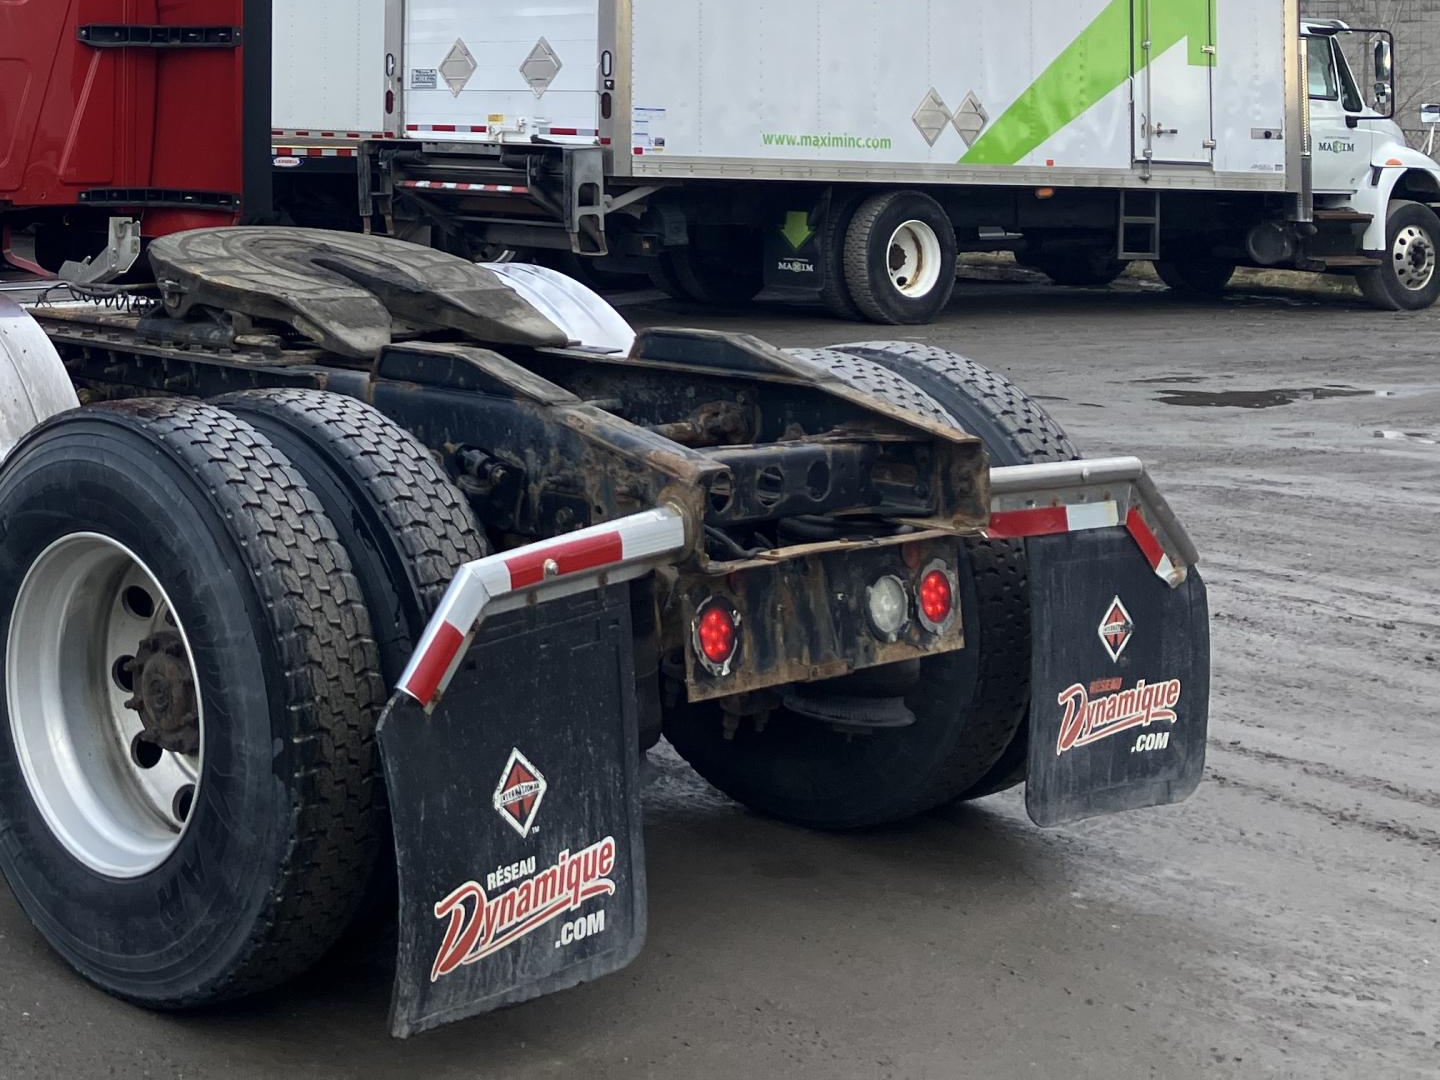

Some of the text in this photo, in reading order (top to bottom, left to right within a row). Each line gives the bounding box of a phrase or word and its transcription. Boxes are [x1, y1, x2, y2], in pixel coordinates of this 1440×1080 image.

[762, 131, 892, 150] www.maximinc.com
[1318, 141, 1355, 154] MAXIM
[778, 261, 815, 274] MAXIM
[1056, 678, 1182, 757] Dynamique
[1130, 731, 1170, 754] .COM
[486, 855, 536, 891] RÉSEAU
[430, 835, 616, 983] Dynamique
[554, 909, 605, 950] .COM
